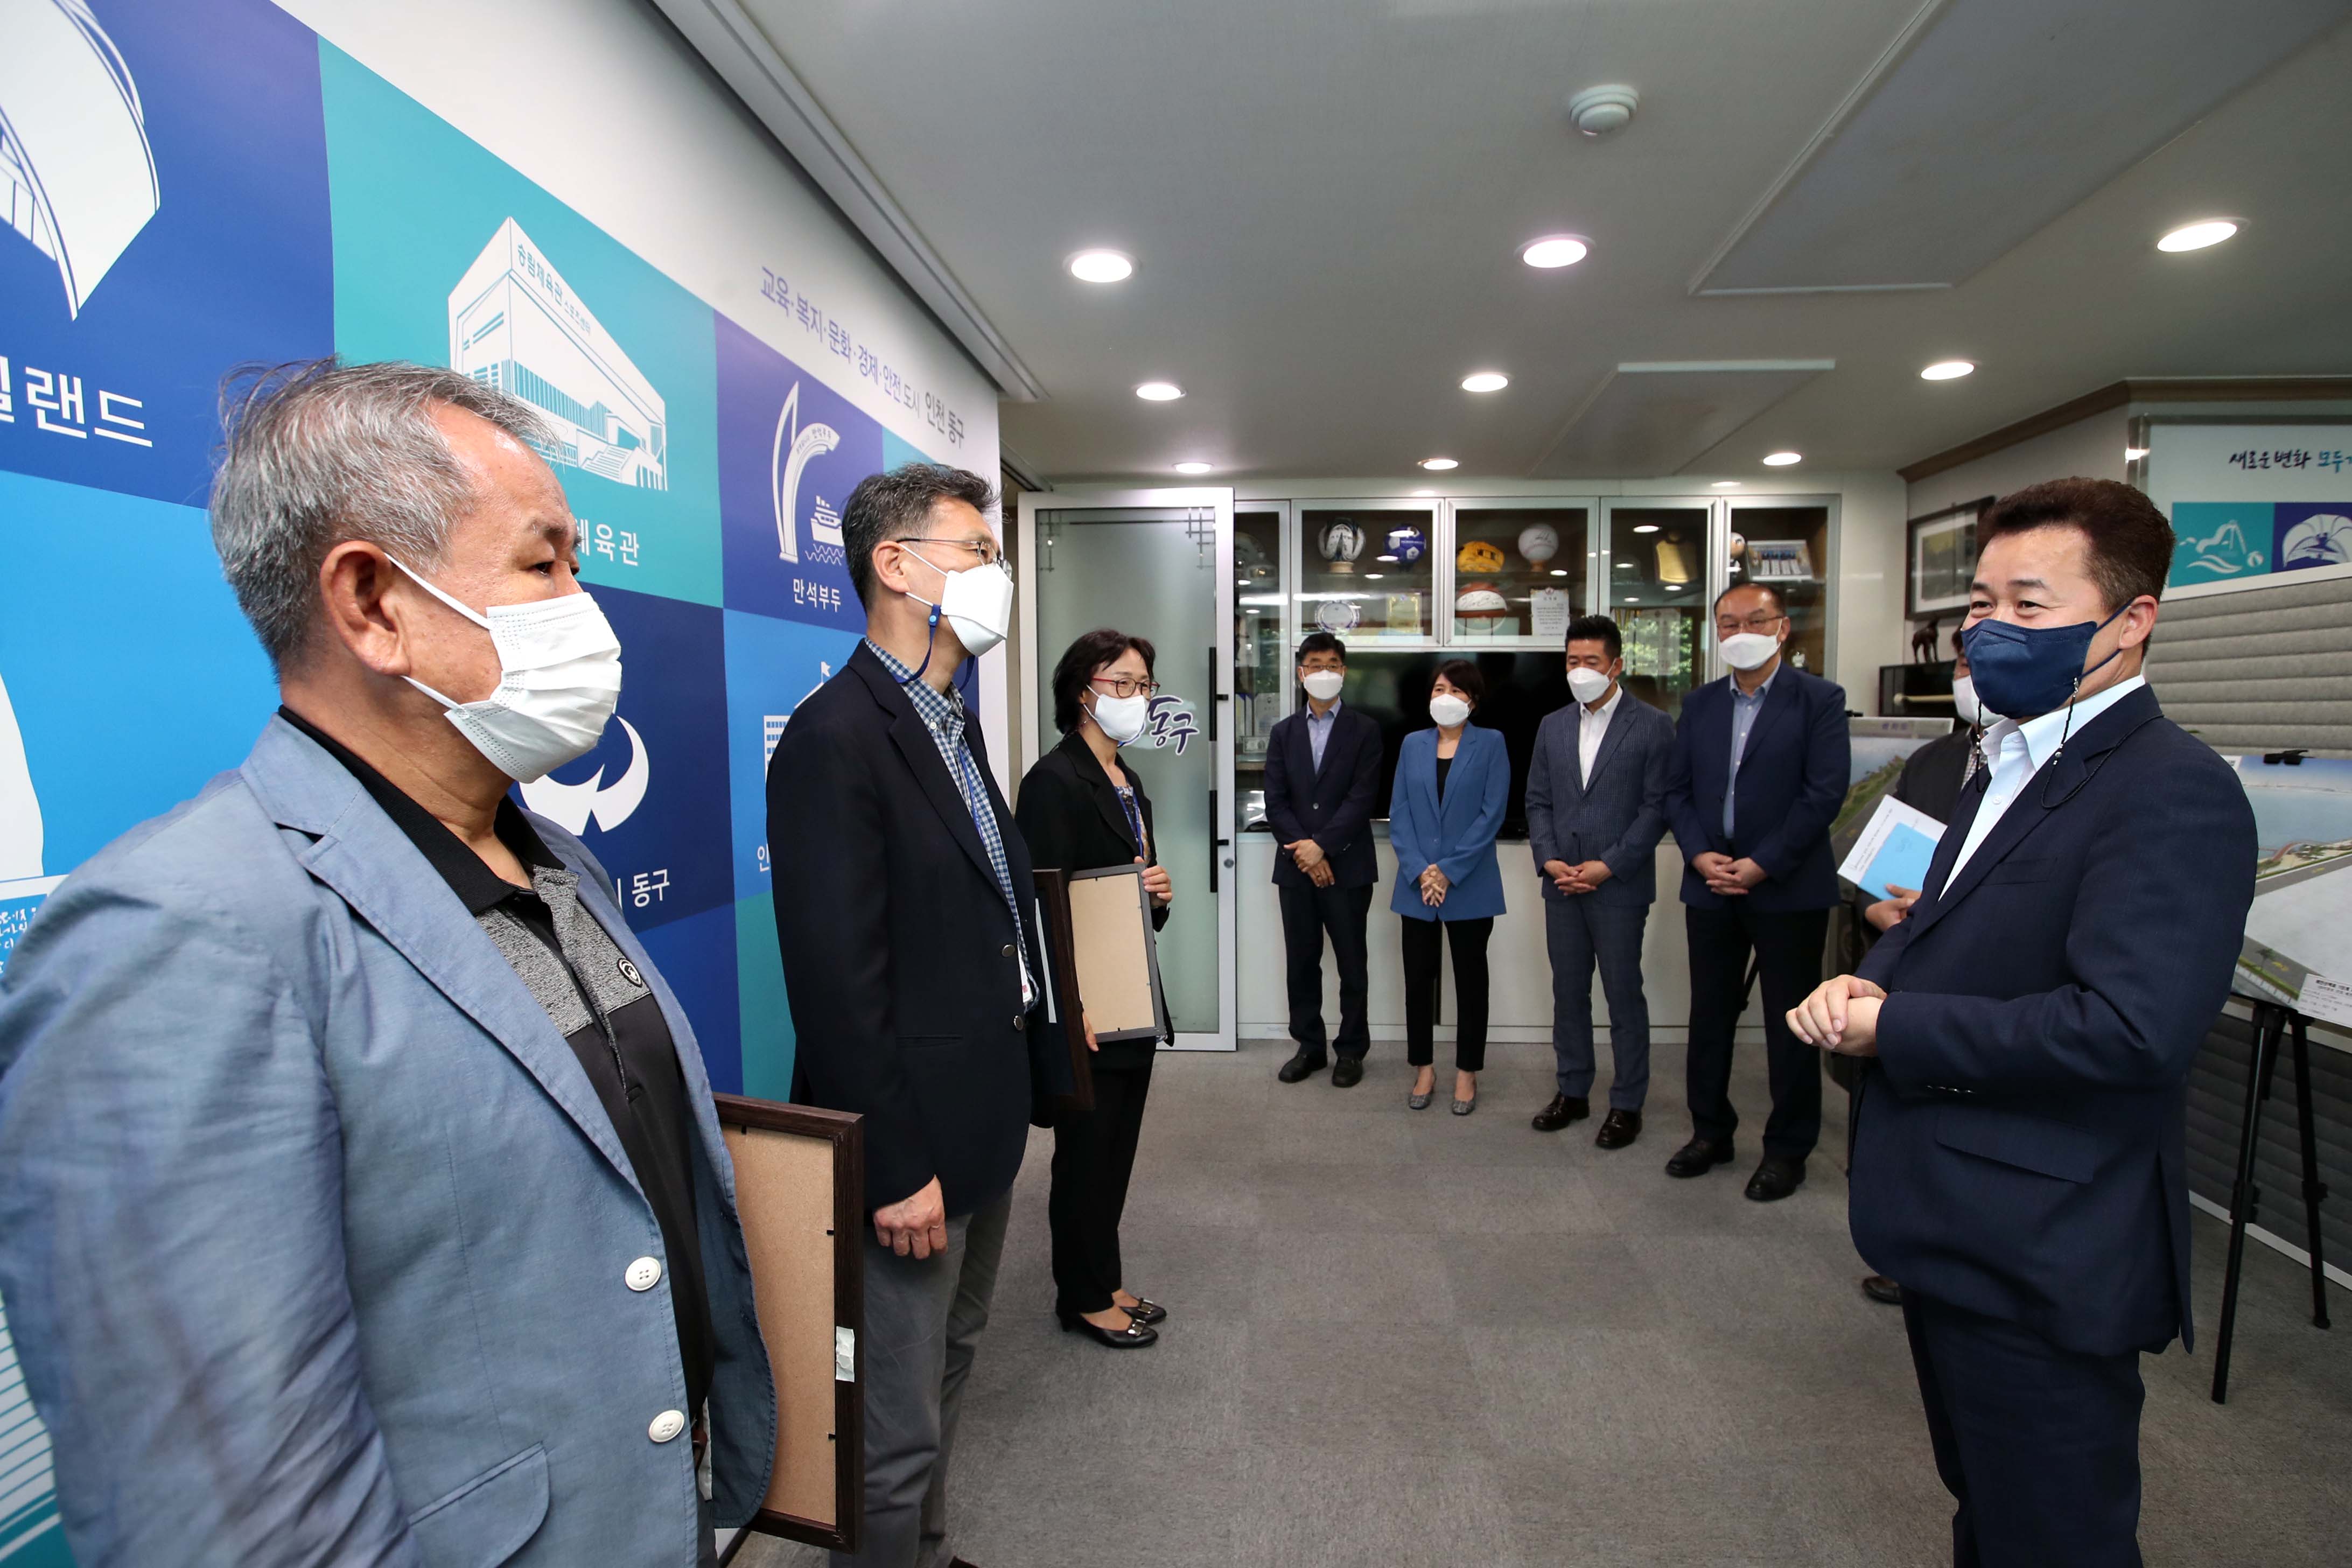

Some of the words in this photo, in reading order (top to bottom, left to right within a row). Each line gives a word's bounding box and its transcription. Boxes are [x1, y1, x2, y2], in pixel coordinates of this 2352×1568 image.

[0, 356, 153, 447] 랜드
[903, 383, 920, 419] 도시
[925, 391, 945, 435] 인천
[948, 410, 964, 450] 동구
[793, 578, 841, 612] 만석부두
[1147, 695, 1200, 755] 동구
[632, 869, 670, 908] 동구
